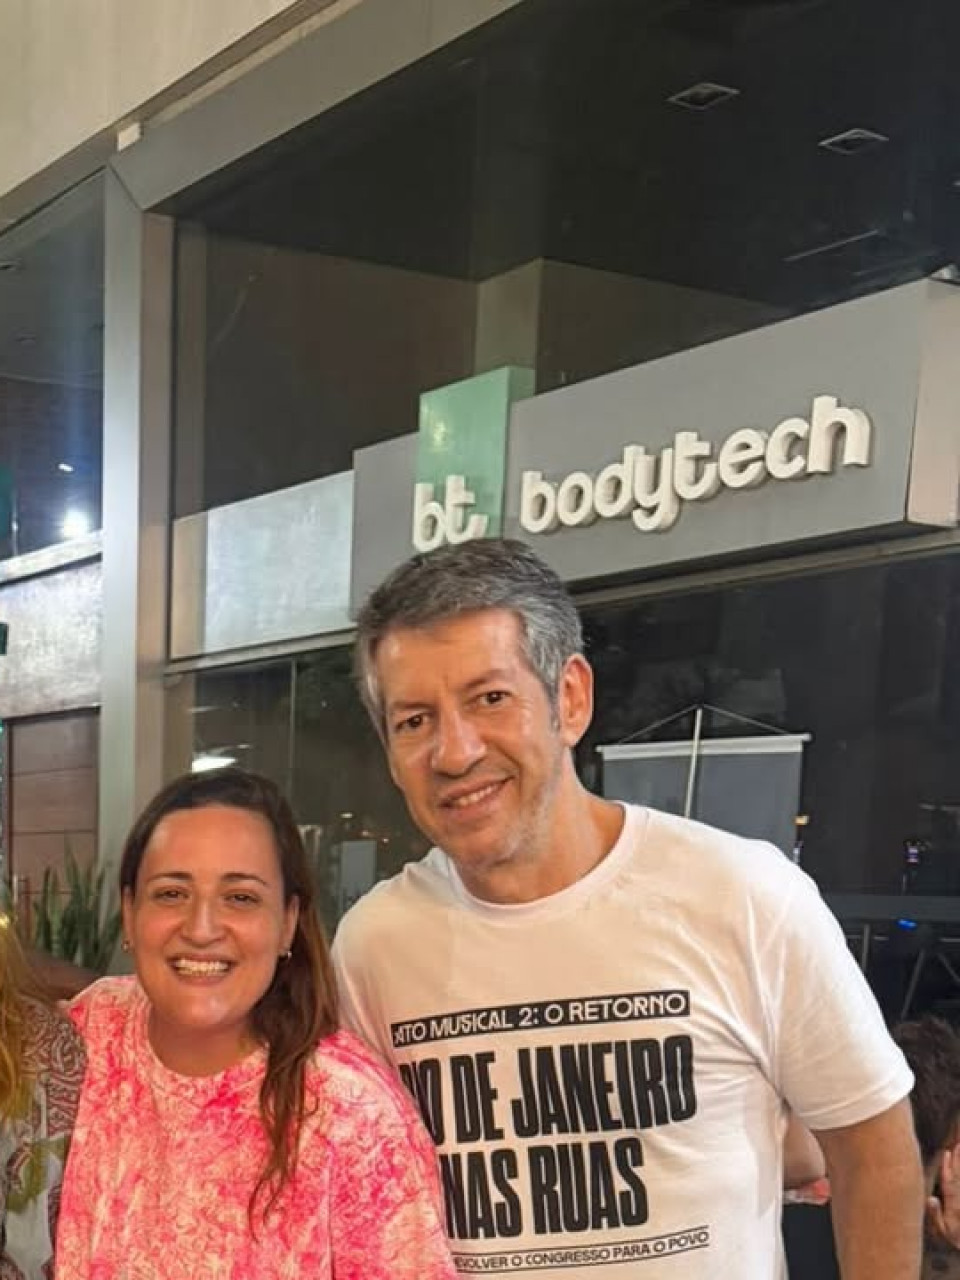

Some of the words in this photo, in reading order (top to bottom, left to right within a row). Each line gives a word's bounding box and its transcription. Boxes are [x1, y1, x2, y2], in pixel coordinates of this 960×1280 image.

[520, 395, 873, 535] bodytech
[412, 474, 488, 552] bt
[429, 1008, 514, 1039] MUSICAL
[518, 1006, 540, 1028] 2:
[543, 1003, 564, 1025] O
[568, 992, 686, 1023] RETORNO
[449, 1050, 506, 1144] DE
[511, 1034, 698, 1139] JANEIRO
[439, 1148, 523, 1240] NAS
[527, 1137, 649, 1235] RUAS
[511, 1254, 523, 1267] O
[525, 1249, 611, 1265] CONGRESSO
[613, 1245, 651, 1259] PARA
[653, 1240, 666, 1252] O
[668, 1230, 710, 1249] POVO
